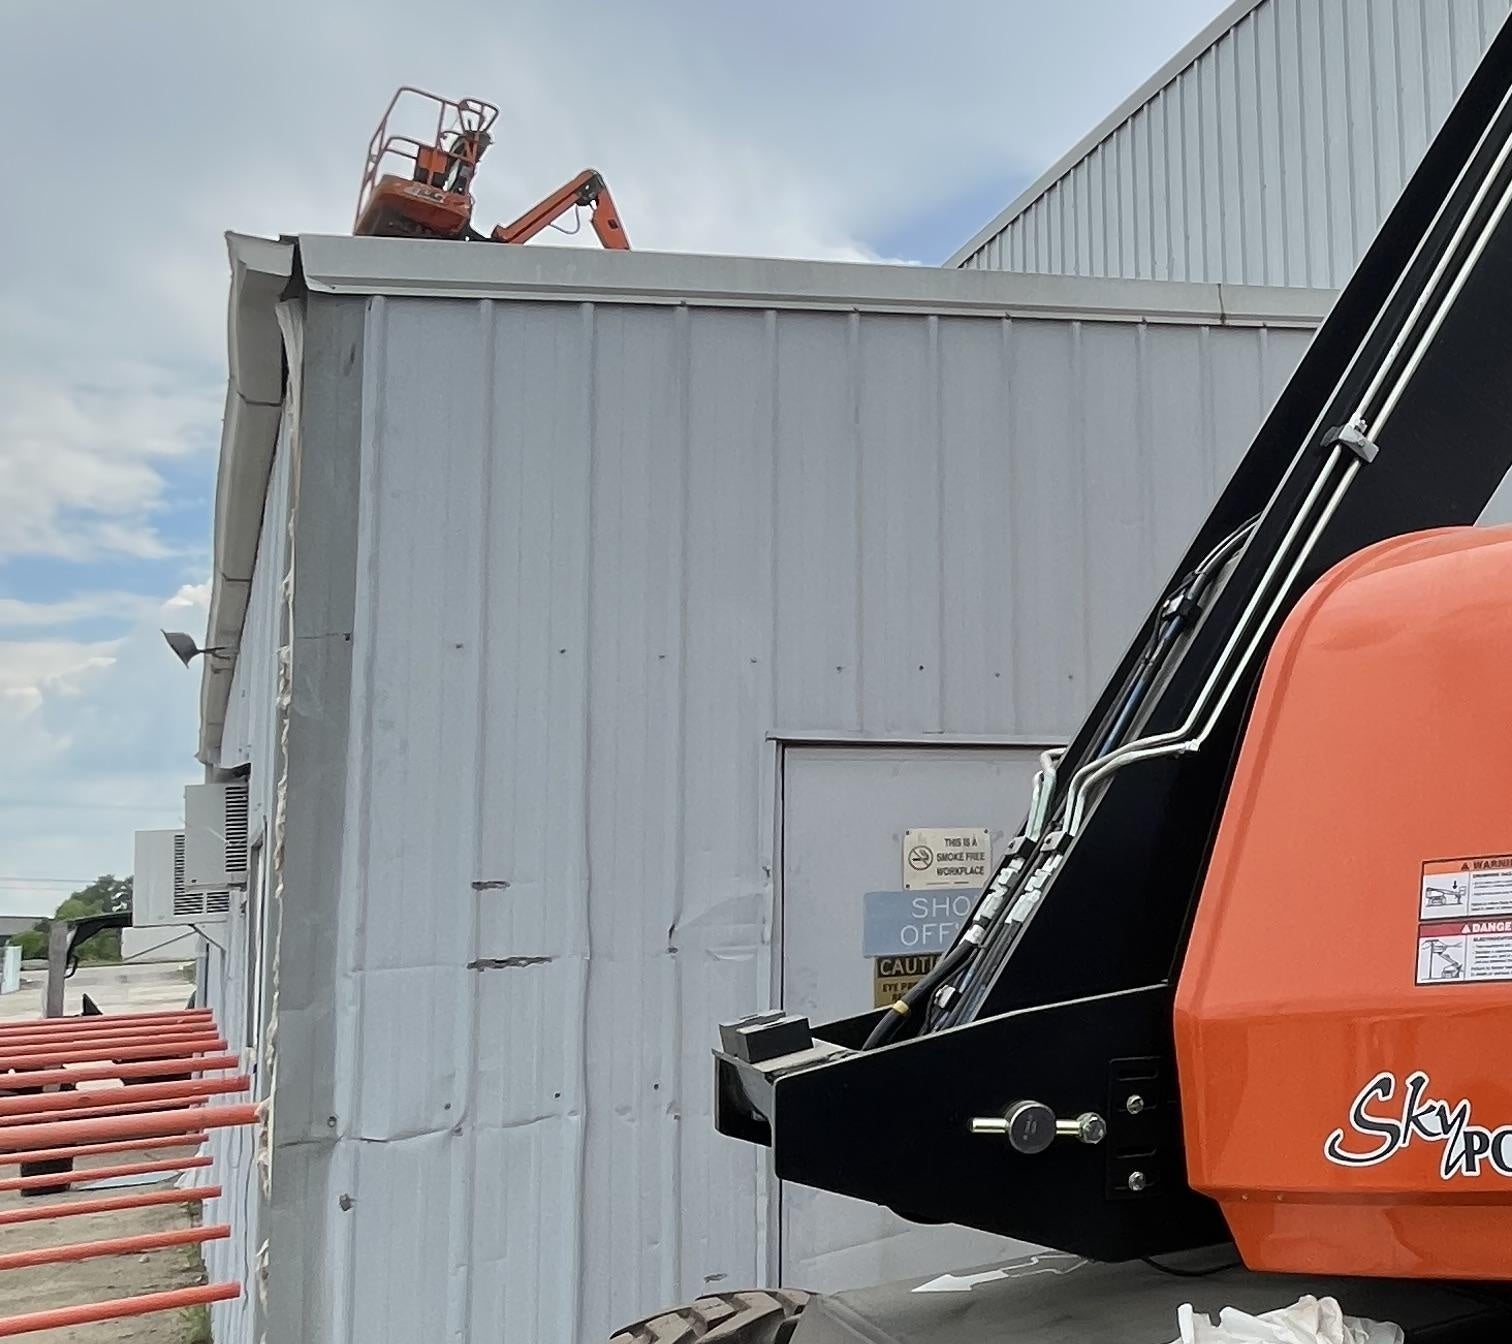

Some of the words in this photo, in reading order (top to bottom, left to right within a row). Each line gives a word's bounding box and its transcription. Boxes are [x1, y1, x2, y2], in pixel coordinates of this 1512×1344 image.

[944, 838, 961, 847] THIS
[963, 838, 971, 847] IS
[936, 852, 964, 862] SMOKE
[966, 851, 986, 861] FREE
[936, 865, 985, 876] WORKPLACE
[911, 895, 978, 919] SHO
[900, 922, 960, 947] OFF
[880, 956, 938, 975] CAUTI
